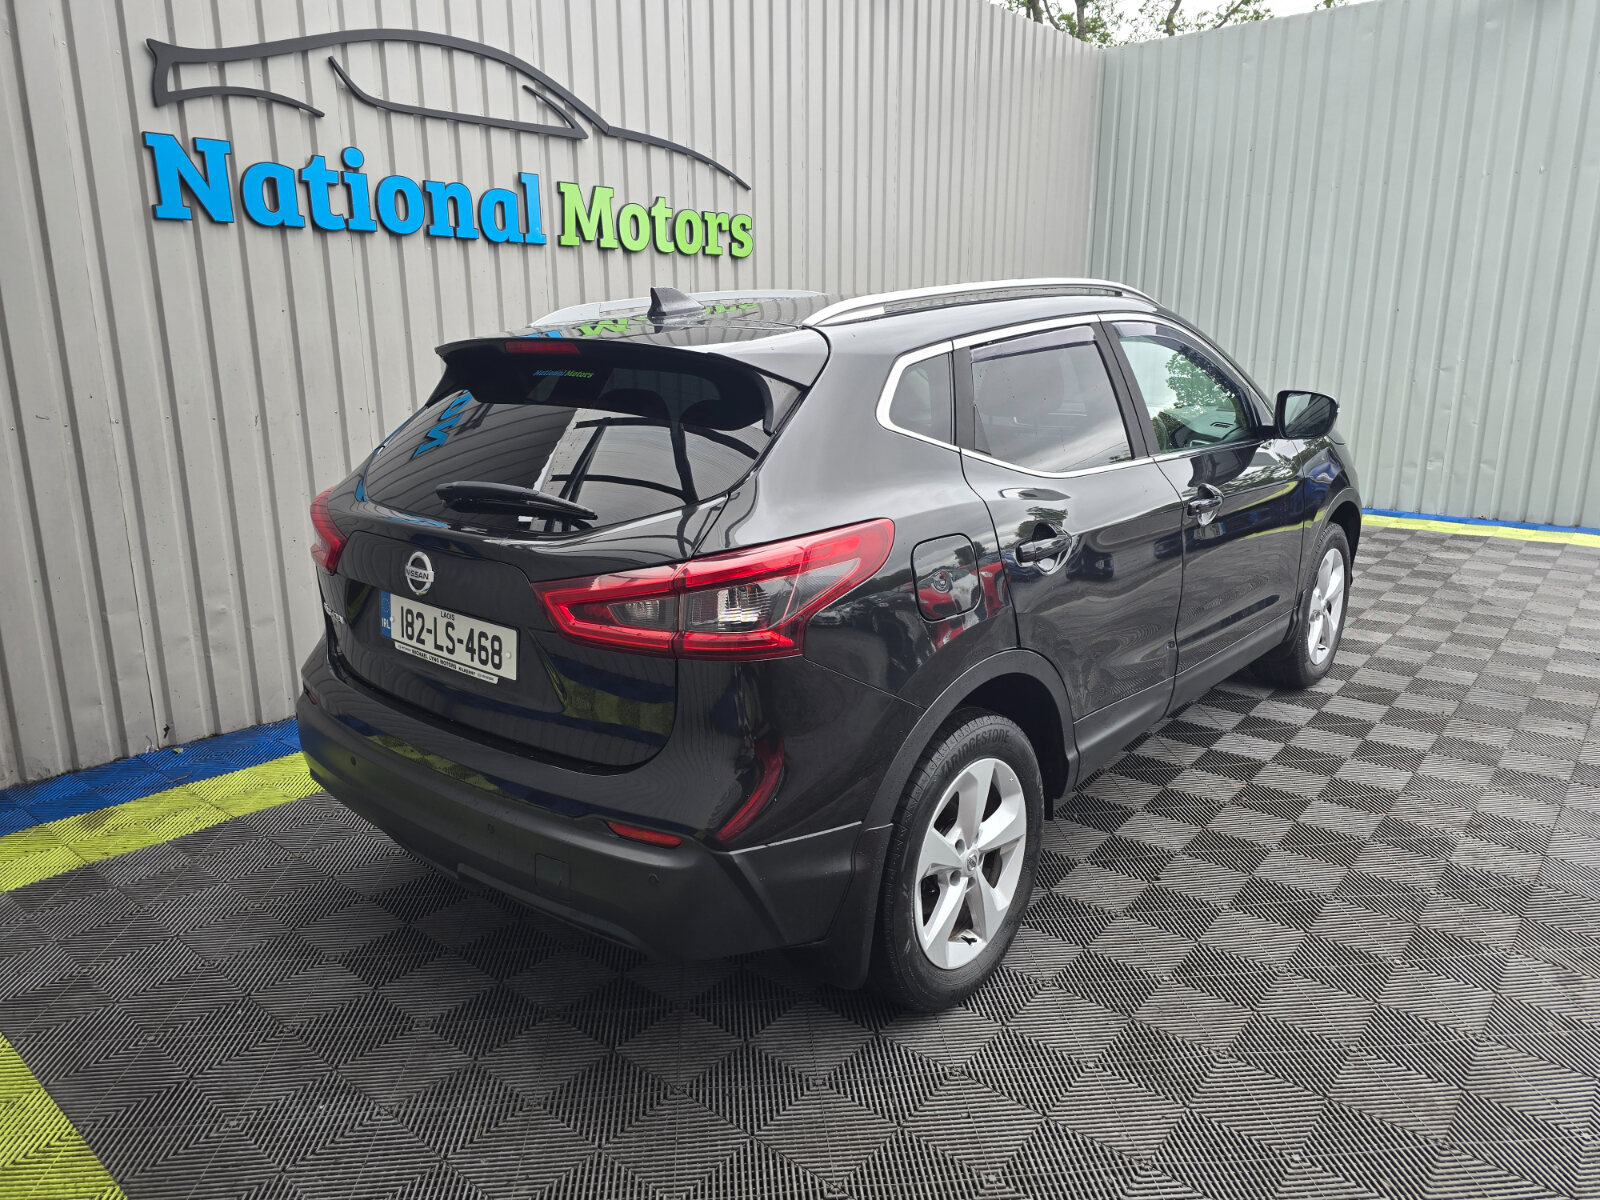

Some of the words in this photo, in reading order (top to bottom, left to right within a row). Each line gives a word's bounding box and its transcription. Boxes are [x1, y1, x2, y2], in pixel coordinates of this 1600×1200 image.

[143, 131, 547, 246] National
[558, 181, 754, 259] Motors
[564, 370, 595, 378] Motors
[406, 568, 430, 581] NISSAN
[440, 610, 456, 621] LAOIS
[381, 617, 391, 630] IRL
[400, 605, 503, 671] 182-LS-468
